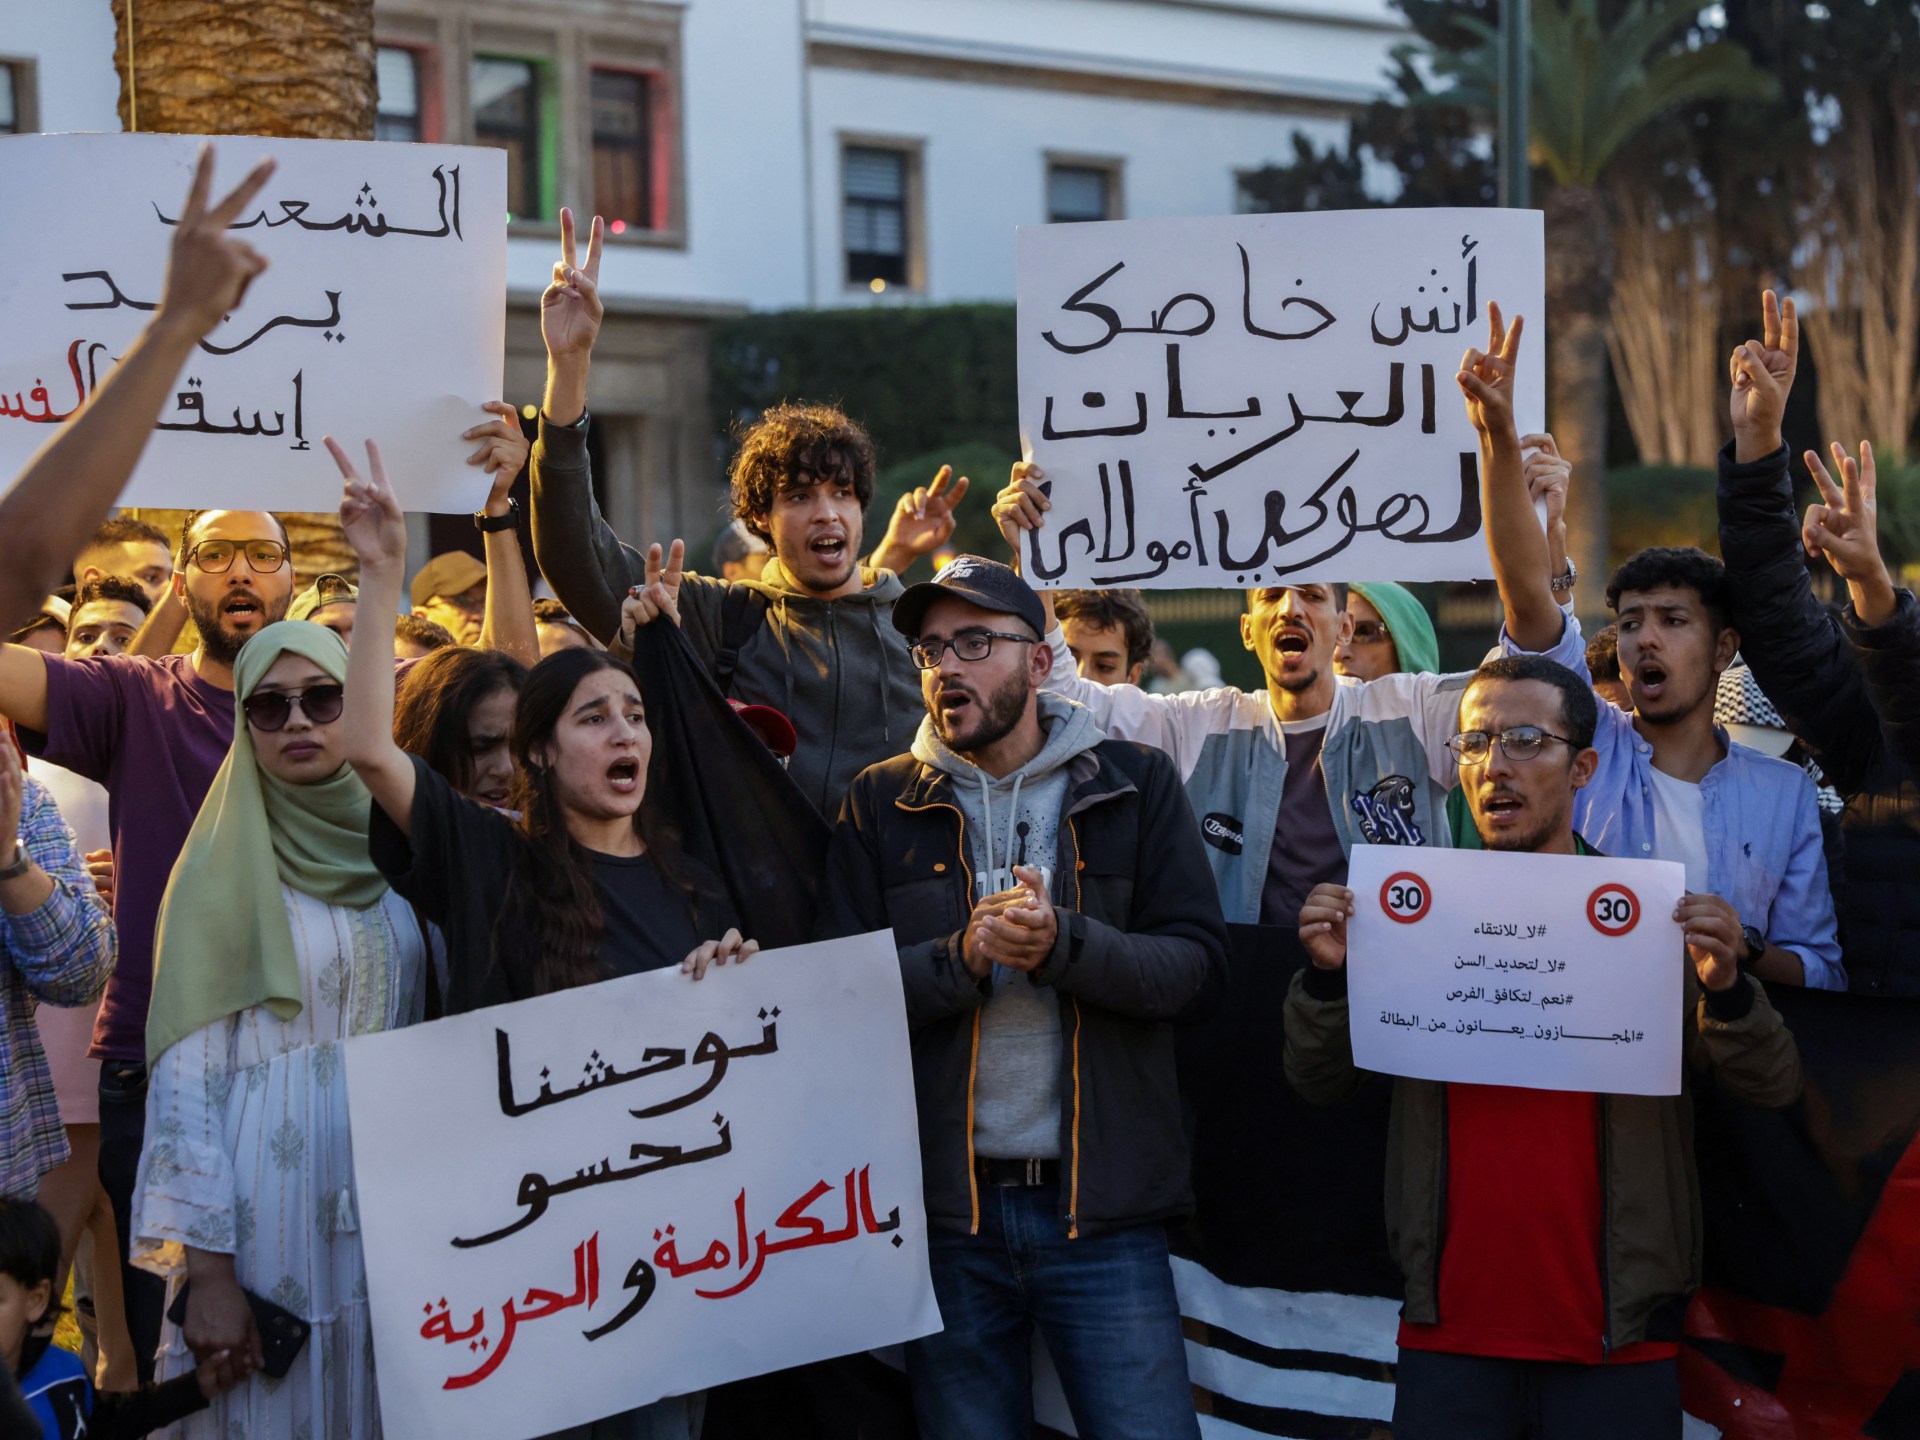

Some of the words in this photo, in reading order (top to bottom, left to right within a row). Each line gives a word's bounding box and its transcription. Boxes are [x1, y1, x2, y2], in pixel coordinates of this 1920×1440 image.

[62, 271, 346, 356] يرد
[1371, 234, 1479, 347] أش
[0, 339, 108, 423] الفس
[111, 357, 310, 451] إسق
[1389, 885, 1423, 910] 30
[1596, 897, 1632, 922] 30
[495, 1006, 782, 1120] توحشنا
[450, 1111, 733, 1249] نحسو
[652, 1163, 904, 1300] بالكرامة
